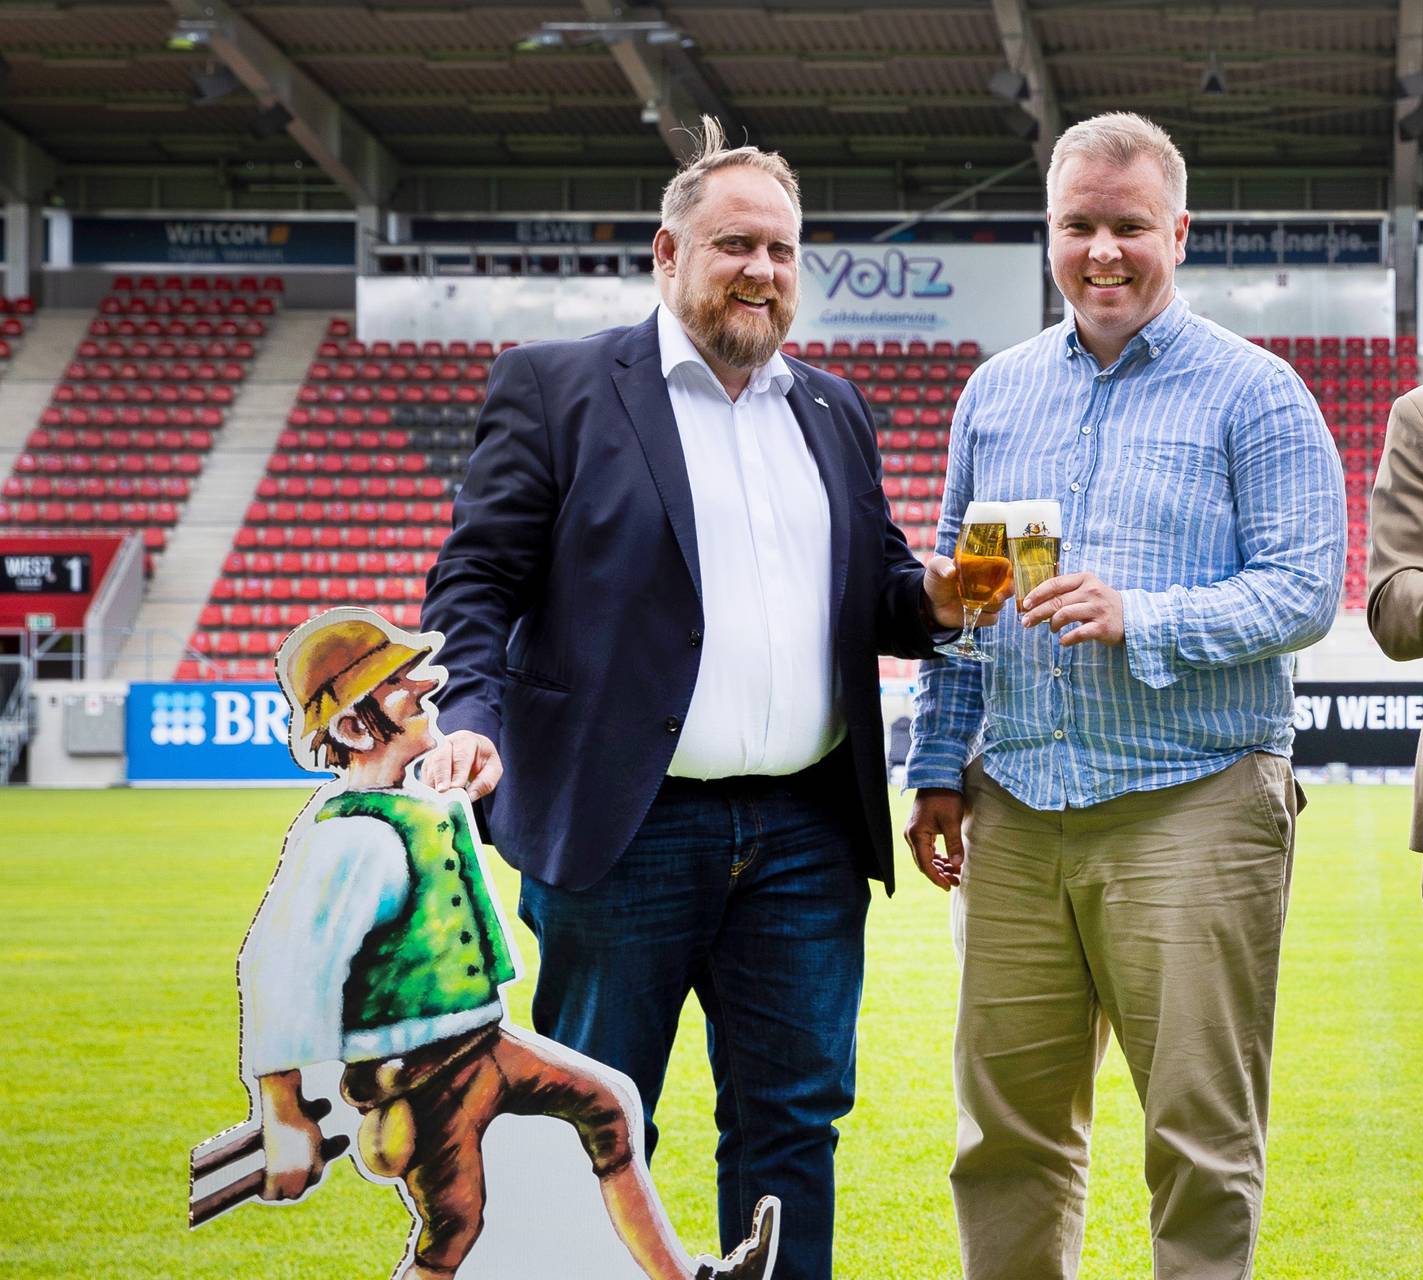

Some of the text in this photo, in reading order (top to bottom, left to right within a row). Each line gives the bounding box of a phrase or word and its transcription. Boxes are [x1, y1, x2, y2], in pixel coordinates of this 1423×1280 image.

[4, 556, 53, 577] WEST
[65, 556, 82, 592] 1
[211, 691, 291, 745] BR
[1294, 695, 1331, 731] SV
